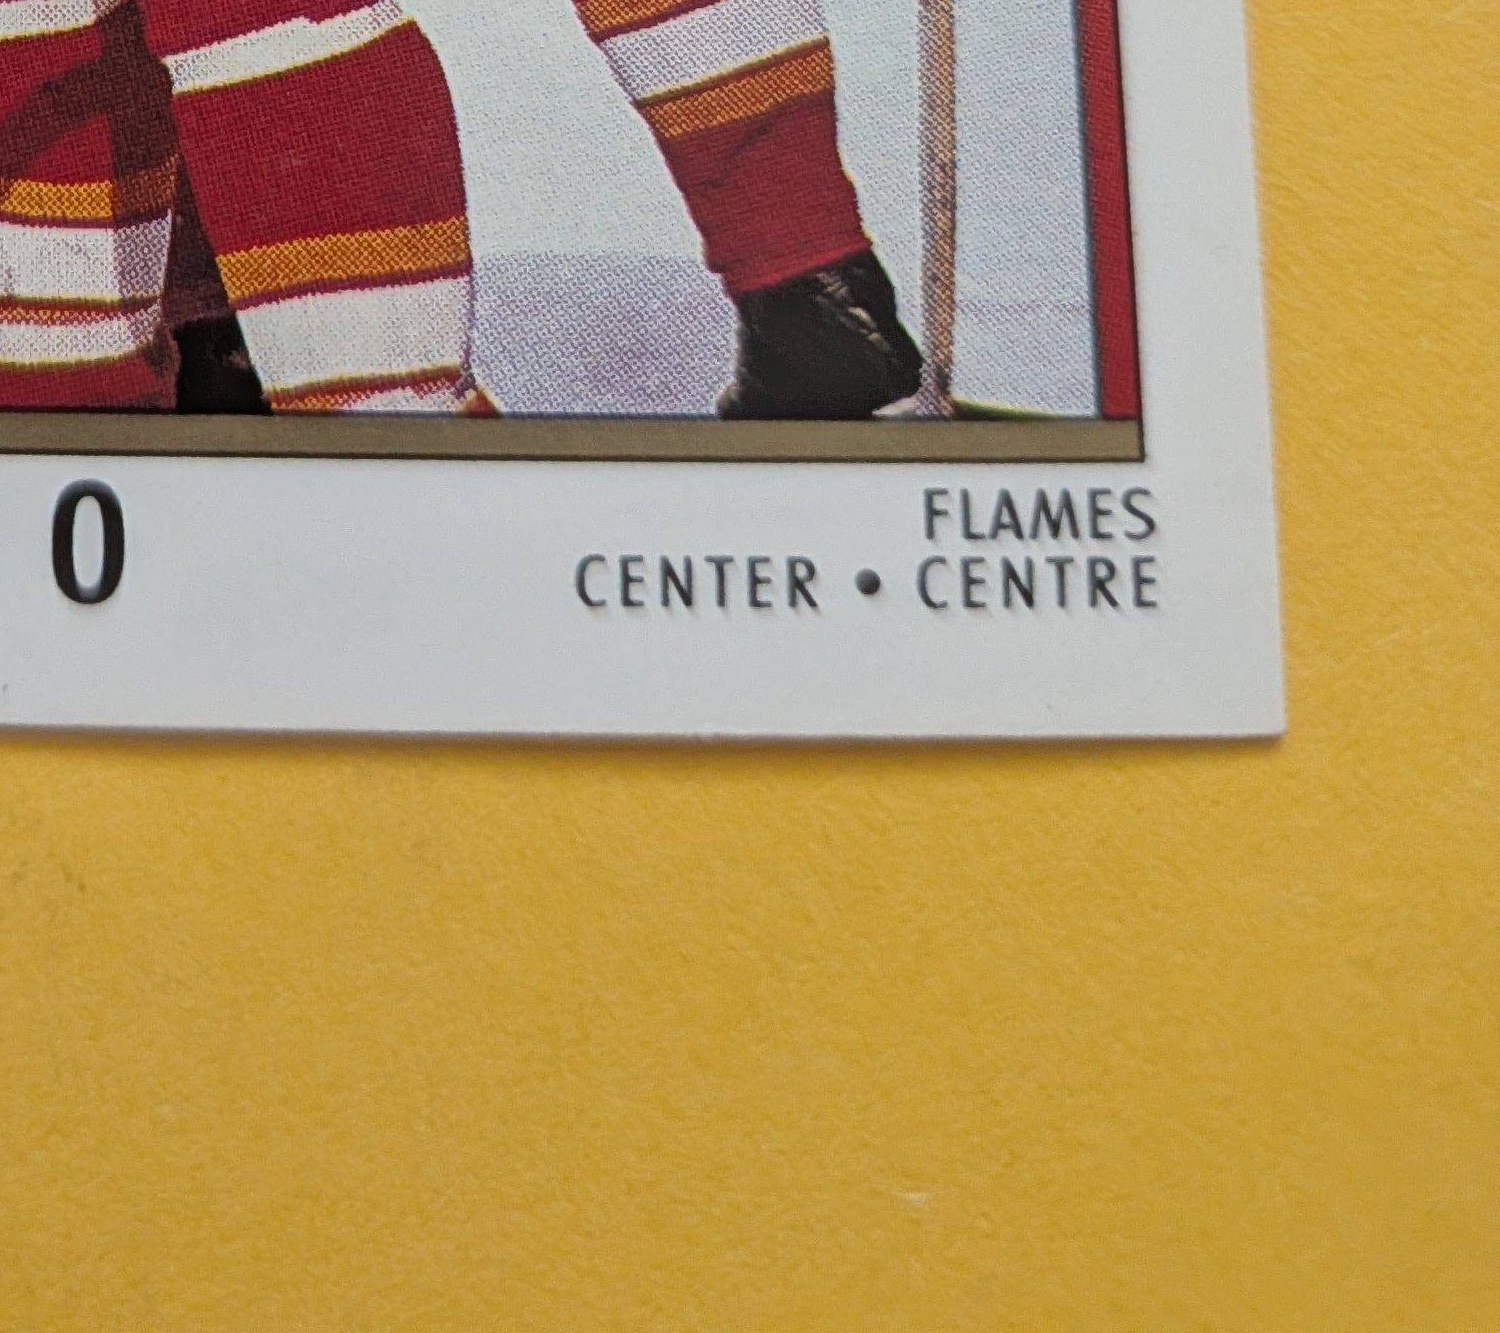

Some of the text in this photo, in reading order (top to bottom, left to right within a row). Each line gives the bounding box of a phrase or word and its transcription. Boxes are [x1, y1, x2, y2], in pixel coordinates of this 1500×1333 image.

[921, 486, 1158, 542] FLAMES
[573, 552, 1159, 610] CENTER CENTRE
